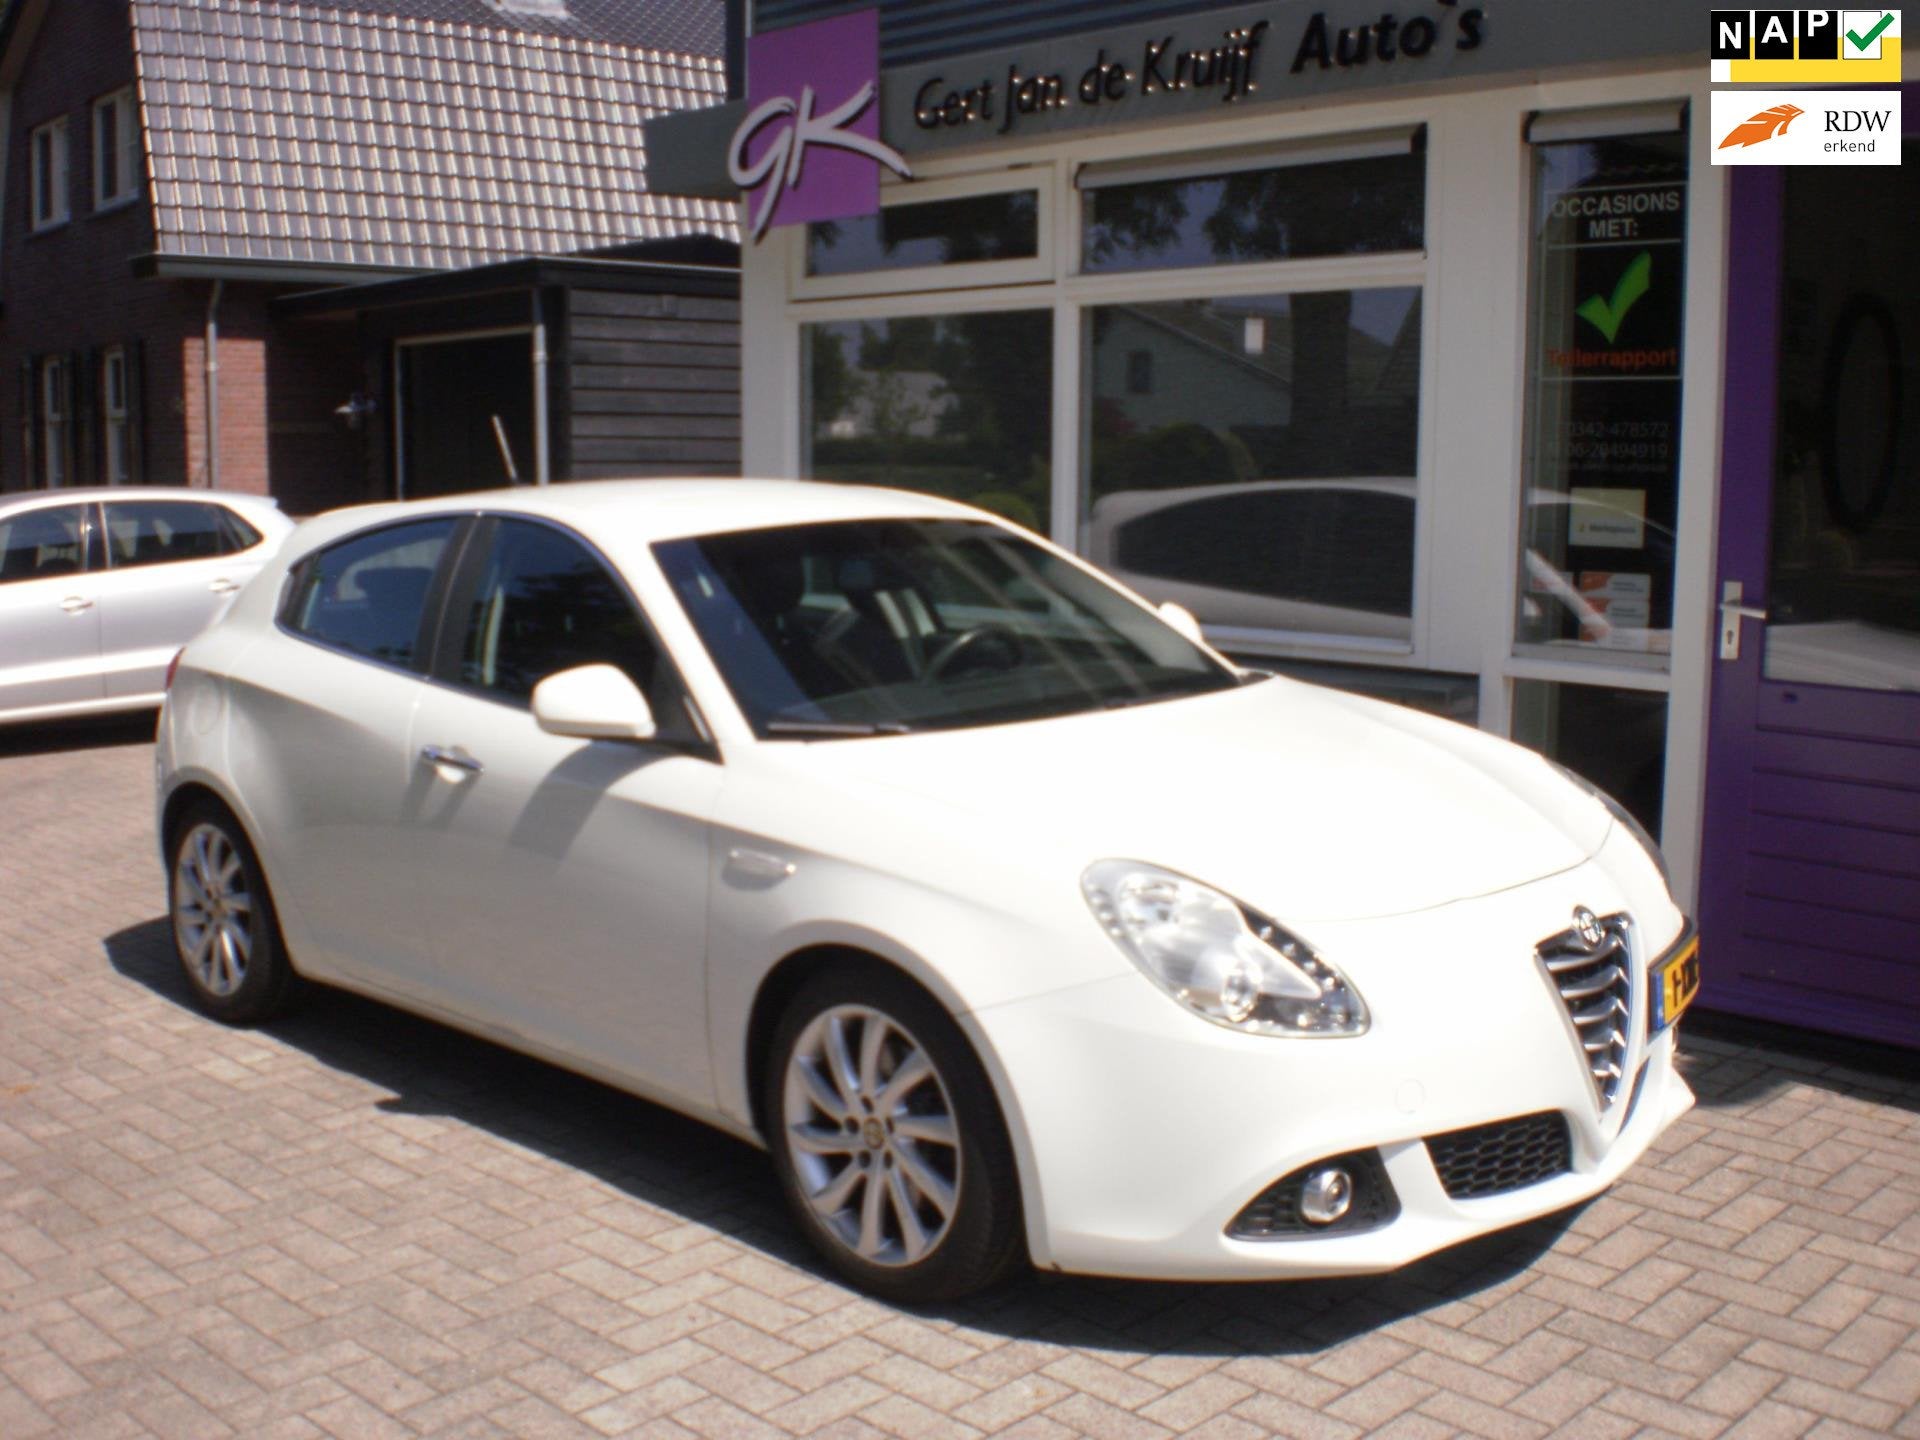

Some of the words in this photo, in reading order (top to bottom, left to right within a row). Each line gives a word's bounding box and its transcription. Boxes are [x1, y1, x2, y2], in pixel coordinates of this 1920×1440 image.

[914, 77, 995, 129] Gert
[998, 65, 1064, 135] Jan
[1079, 49, 1128, 104] de
[1141, 20, 1269, 103] Kruijf
[1552, 190, 1681, 217] OCCASIONS
[1589, 218, 1640, 239] MET:
